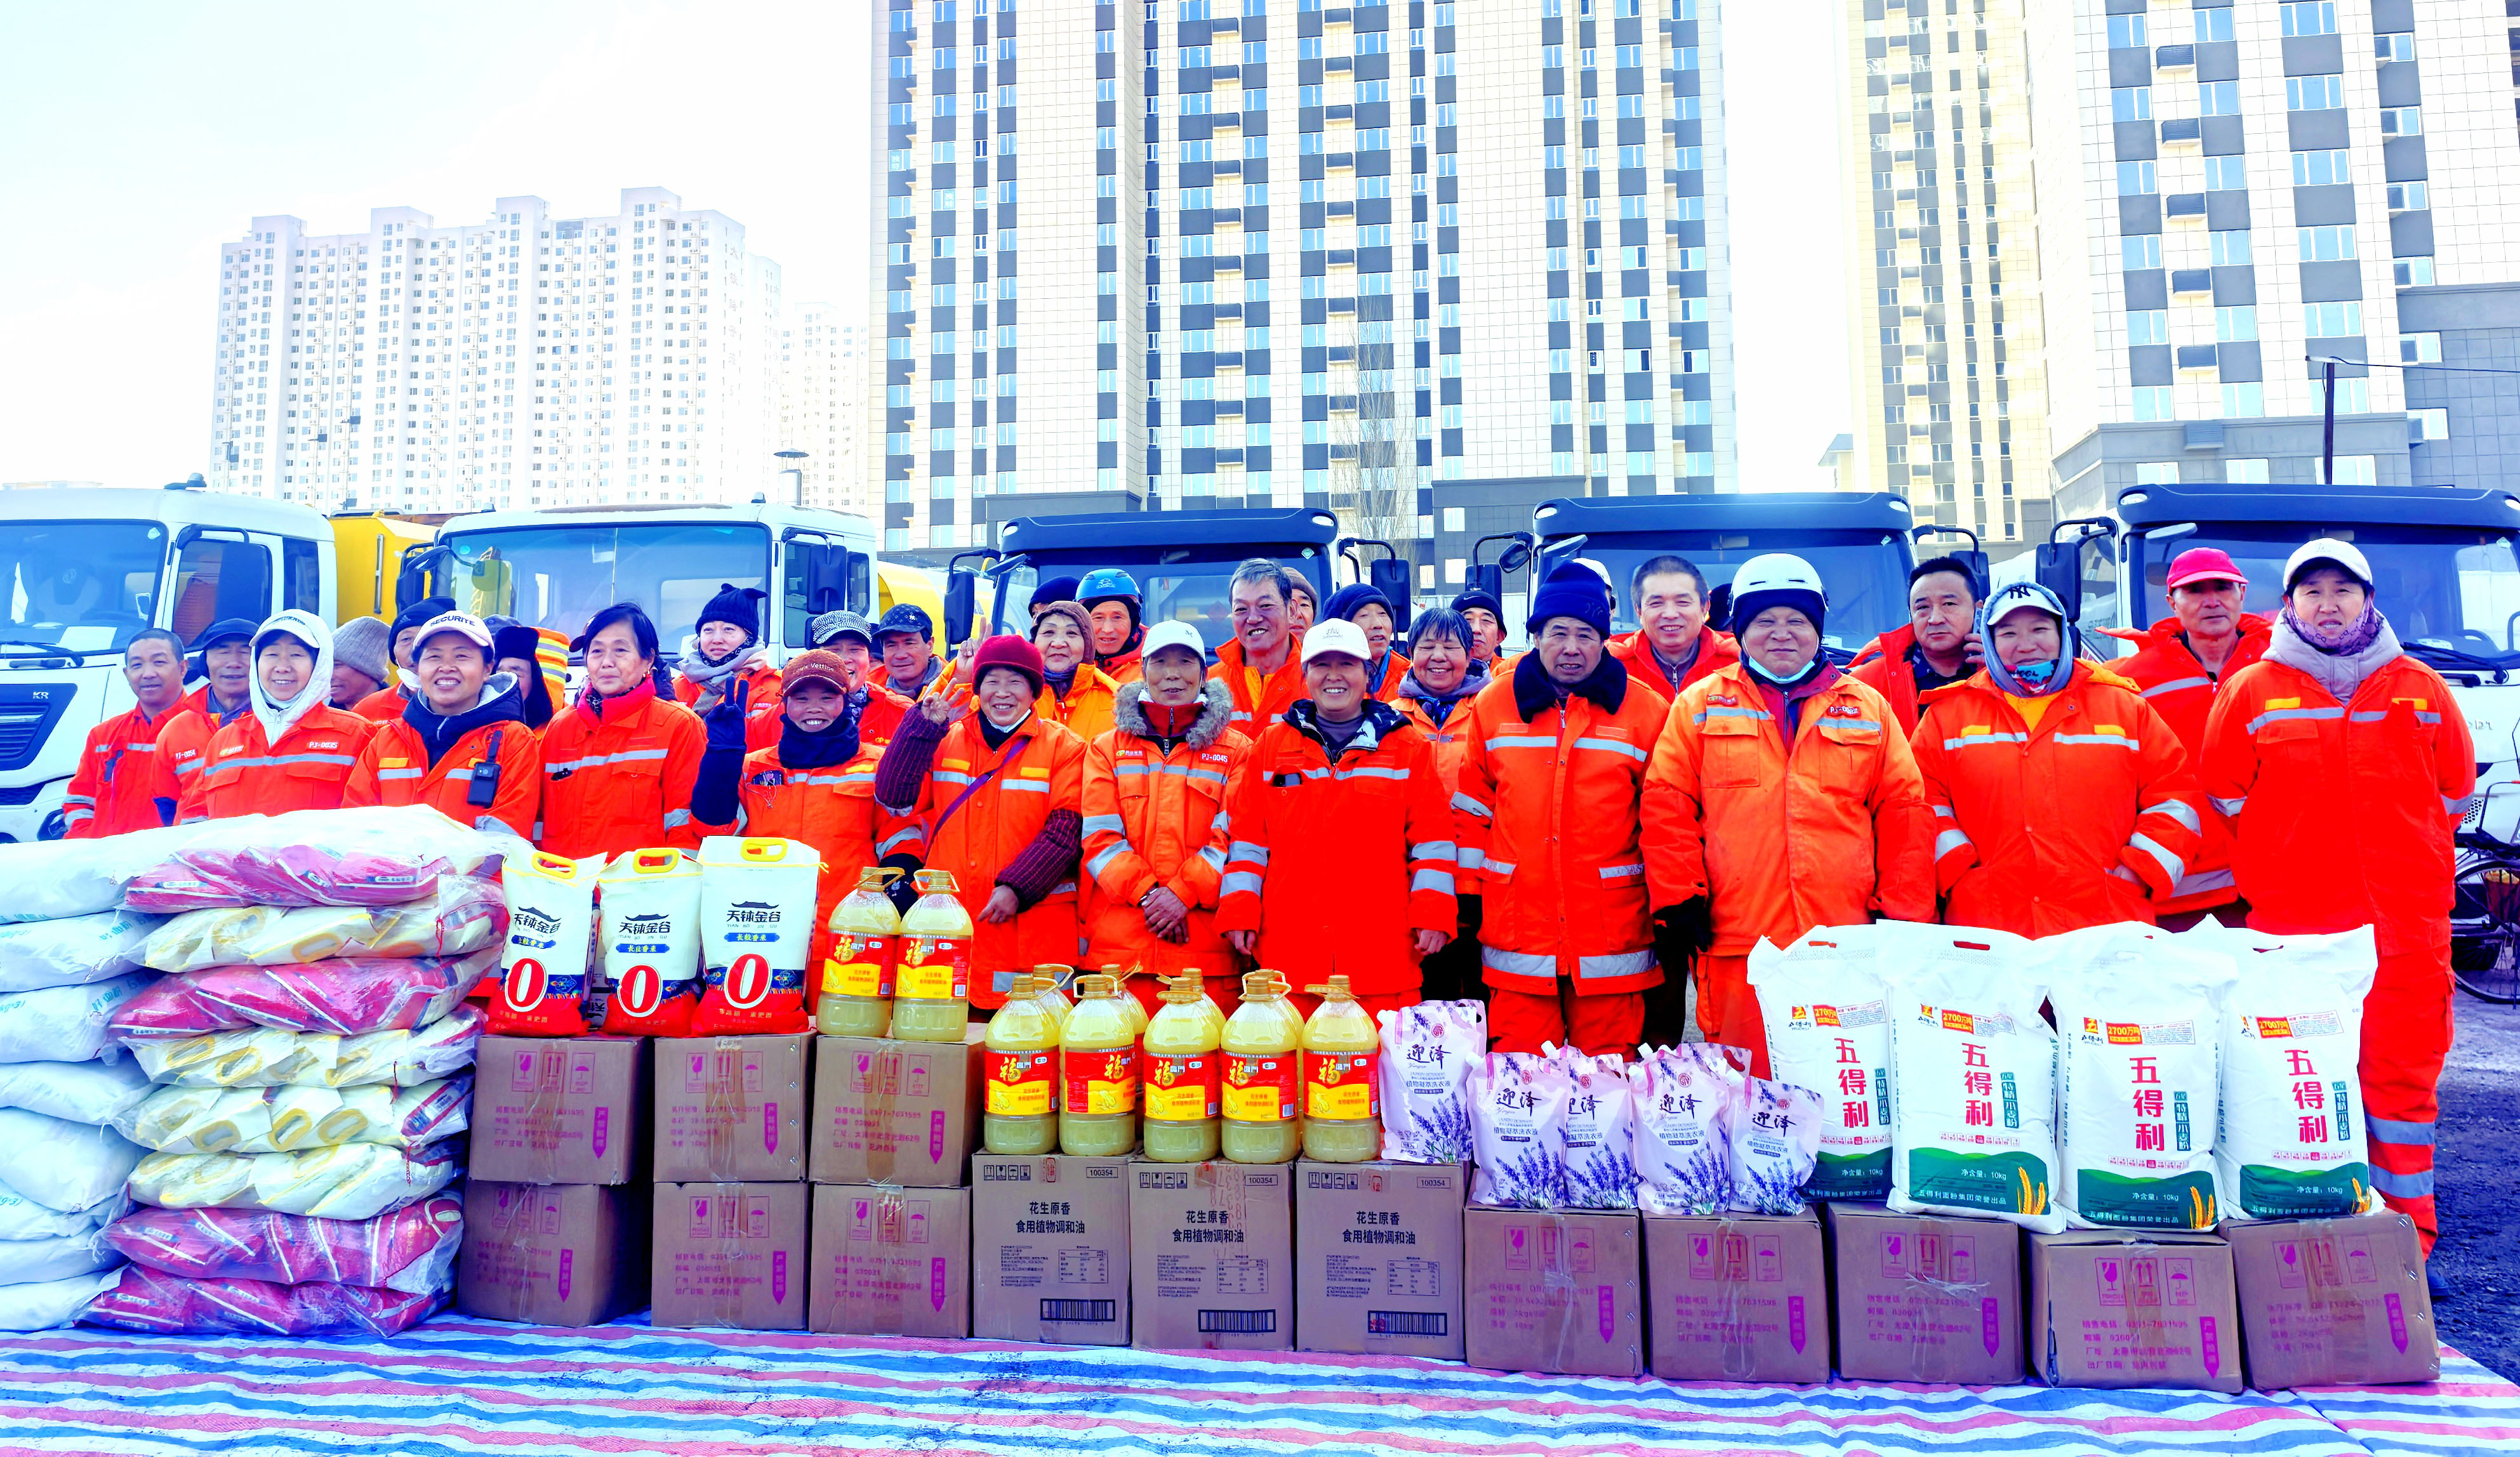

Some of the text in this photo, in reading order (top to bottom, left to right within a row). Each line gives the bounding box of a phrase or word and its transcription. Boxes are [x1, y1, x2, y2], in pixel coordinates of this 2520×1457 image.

[430, 616, 475, 626] SECURITE
[1202, 753, 1228, 763] PJ-0045
[505, 957, 548, 1012] 0
[724, 953, 773, 1009] 0
[617, 964, 663, 1018] 0
[1943, 1013, 1973, 1024] 2700万吨
[2108, 1026, 2140, 1036] 2700万吨
[1407, 1045, 1452, 1069] 迎泽
[1834, 1038, 1869, 1128] 五得利
[1961, 1043, 1993, 1126] 五得利
[1495, 1088, 1542, 1117] 迎泽
[1659, 1093, 1702, 1119] 迎泽
[2130, 1057, 2165, 1151] 五得利
[2285, 1049, 2328, 1144] 五得利
[1752, 1112, 1797, 1137] 迎泽
[1919, 1190, 2006, 1204] 五得利面粉集团荣誉出品
[1030, 1201, 1071, 1215] 花生原香
[1186, 1210, 1228, 1224] 花生原香
[1016, 1220, 1085, 1234] 食用植物调和油
[1356, 1211, 1400, 1225] 花生原香
[1172, 1229, 1244, 1243] 食用植物调和油
[1342, 1229, 1416, 1244] 食用植物调和油
